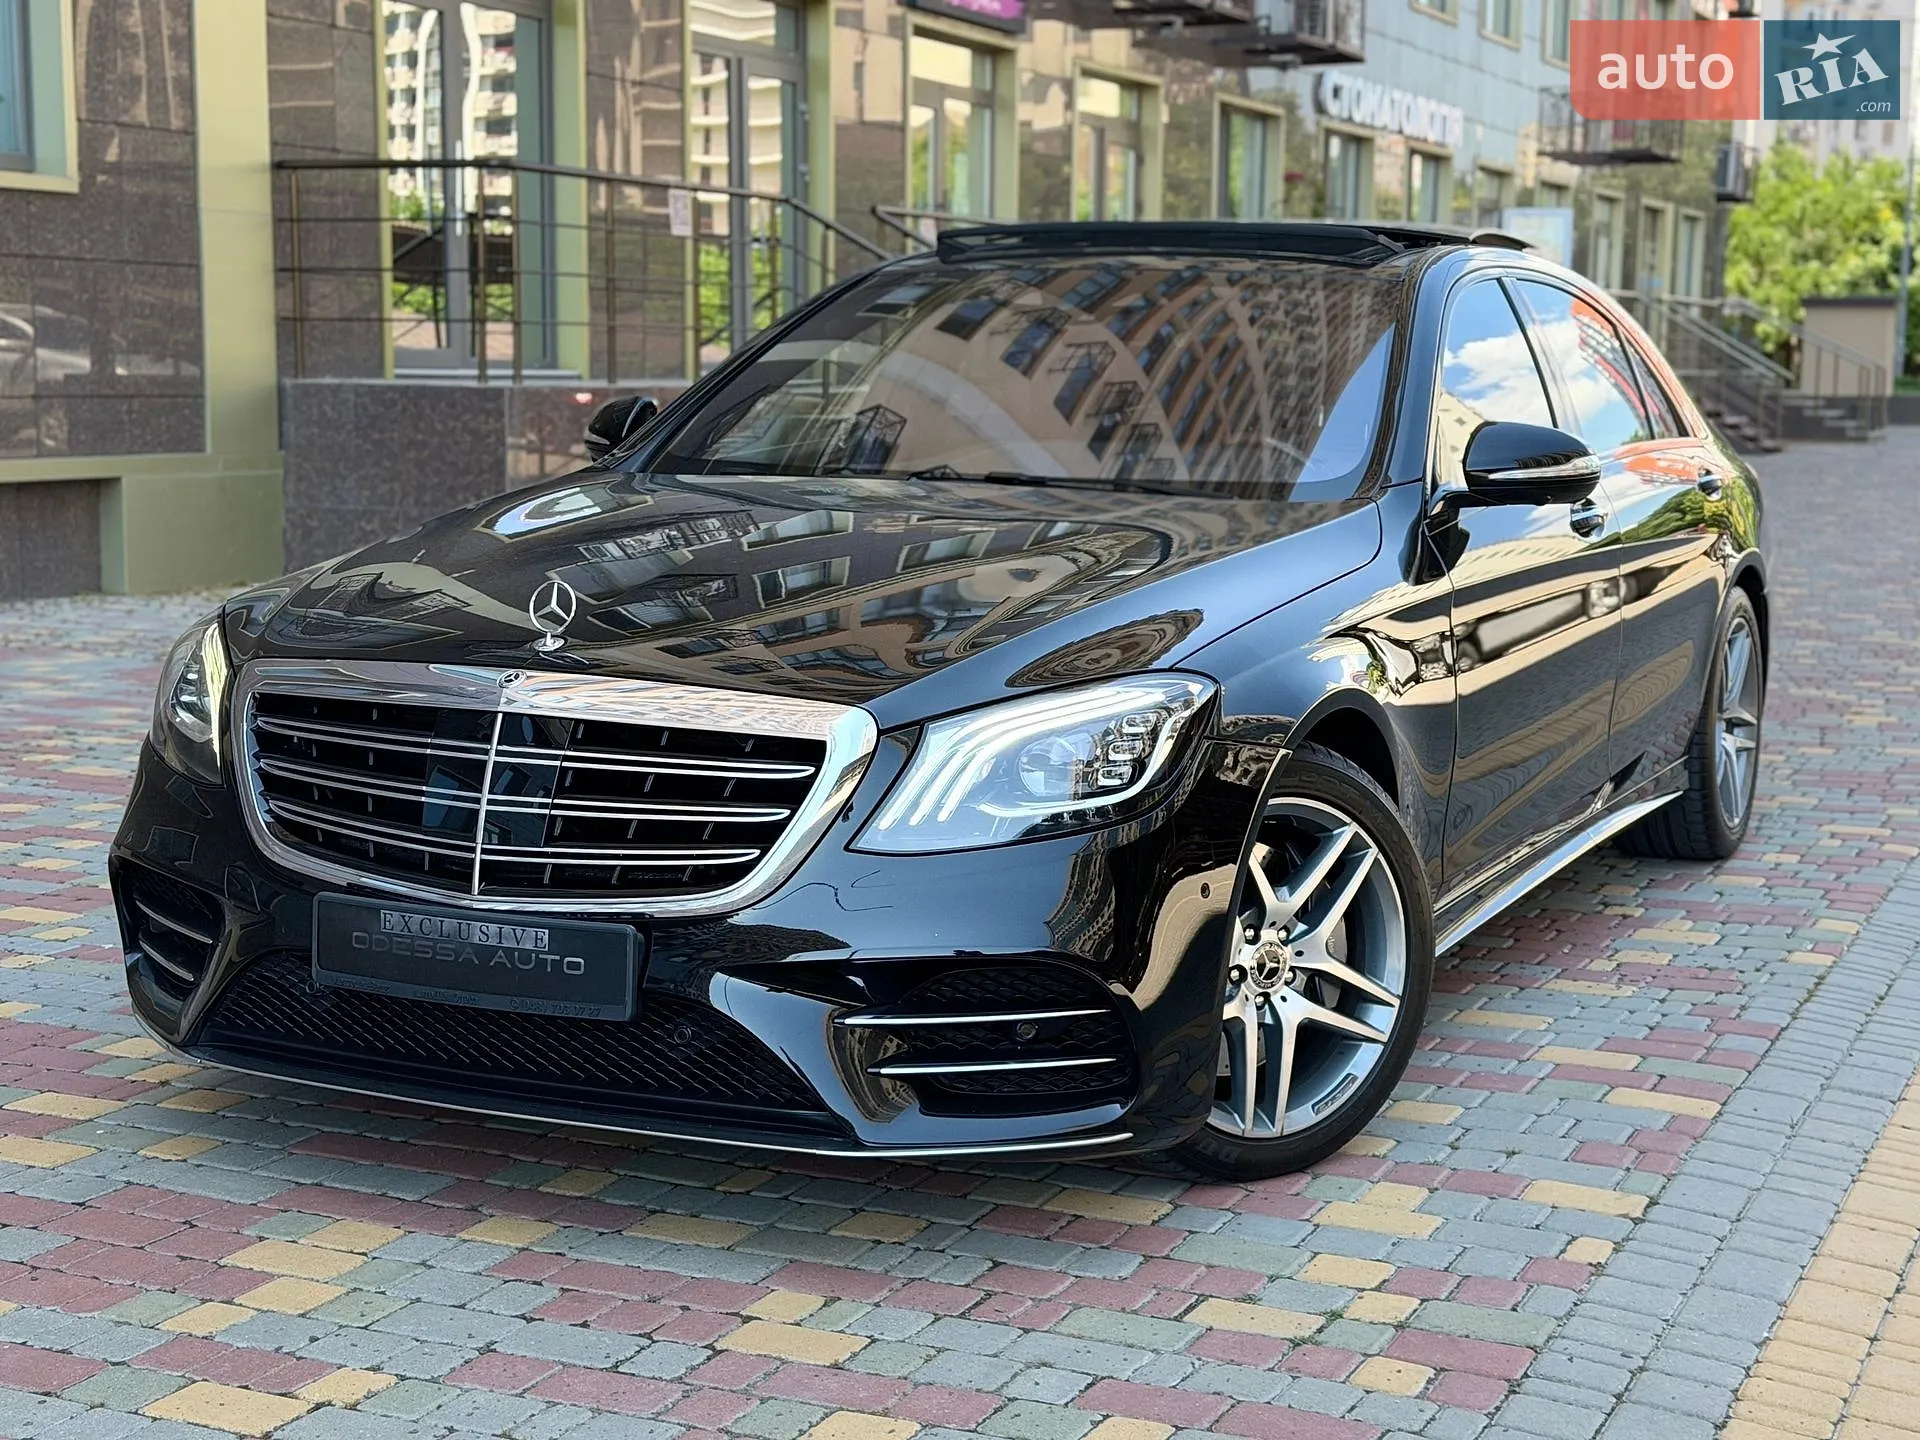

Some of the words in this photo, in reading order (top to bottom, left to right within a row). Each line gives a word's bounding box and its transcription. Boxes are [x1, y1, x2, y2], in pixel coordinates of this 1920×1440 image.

[381, 911, 549, 950] EXCLUSIVE
[352, 931, 480, 964] ODESSA
[489, 949, 585, 975] AUTO
